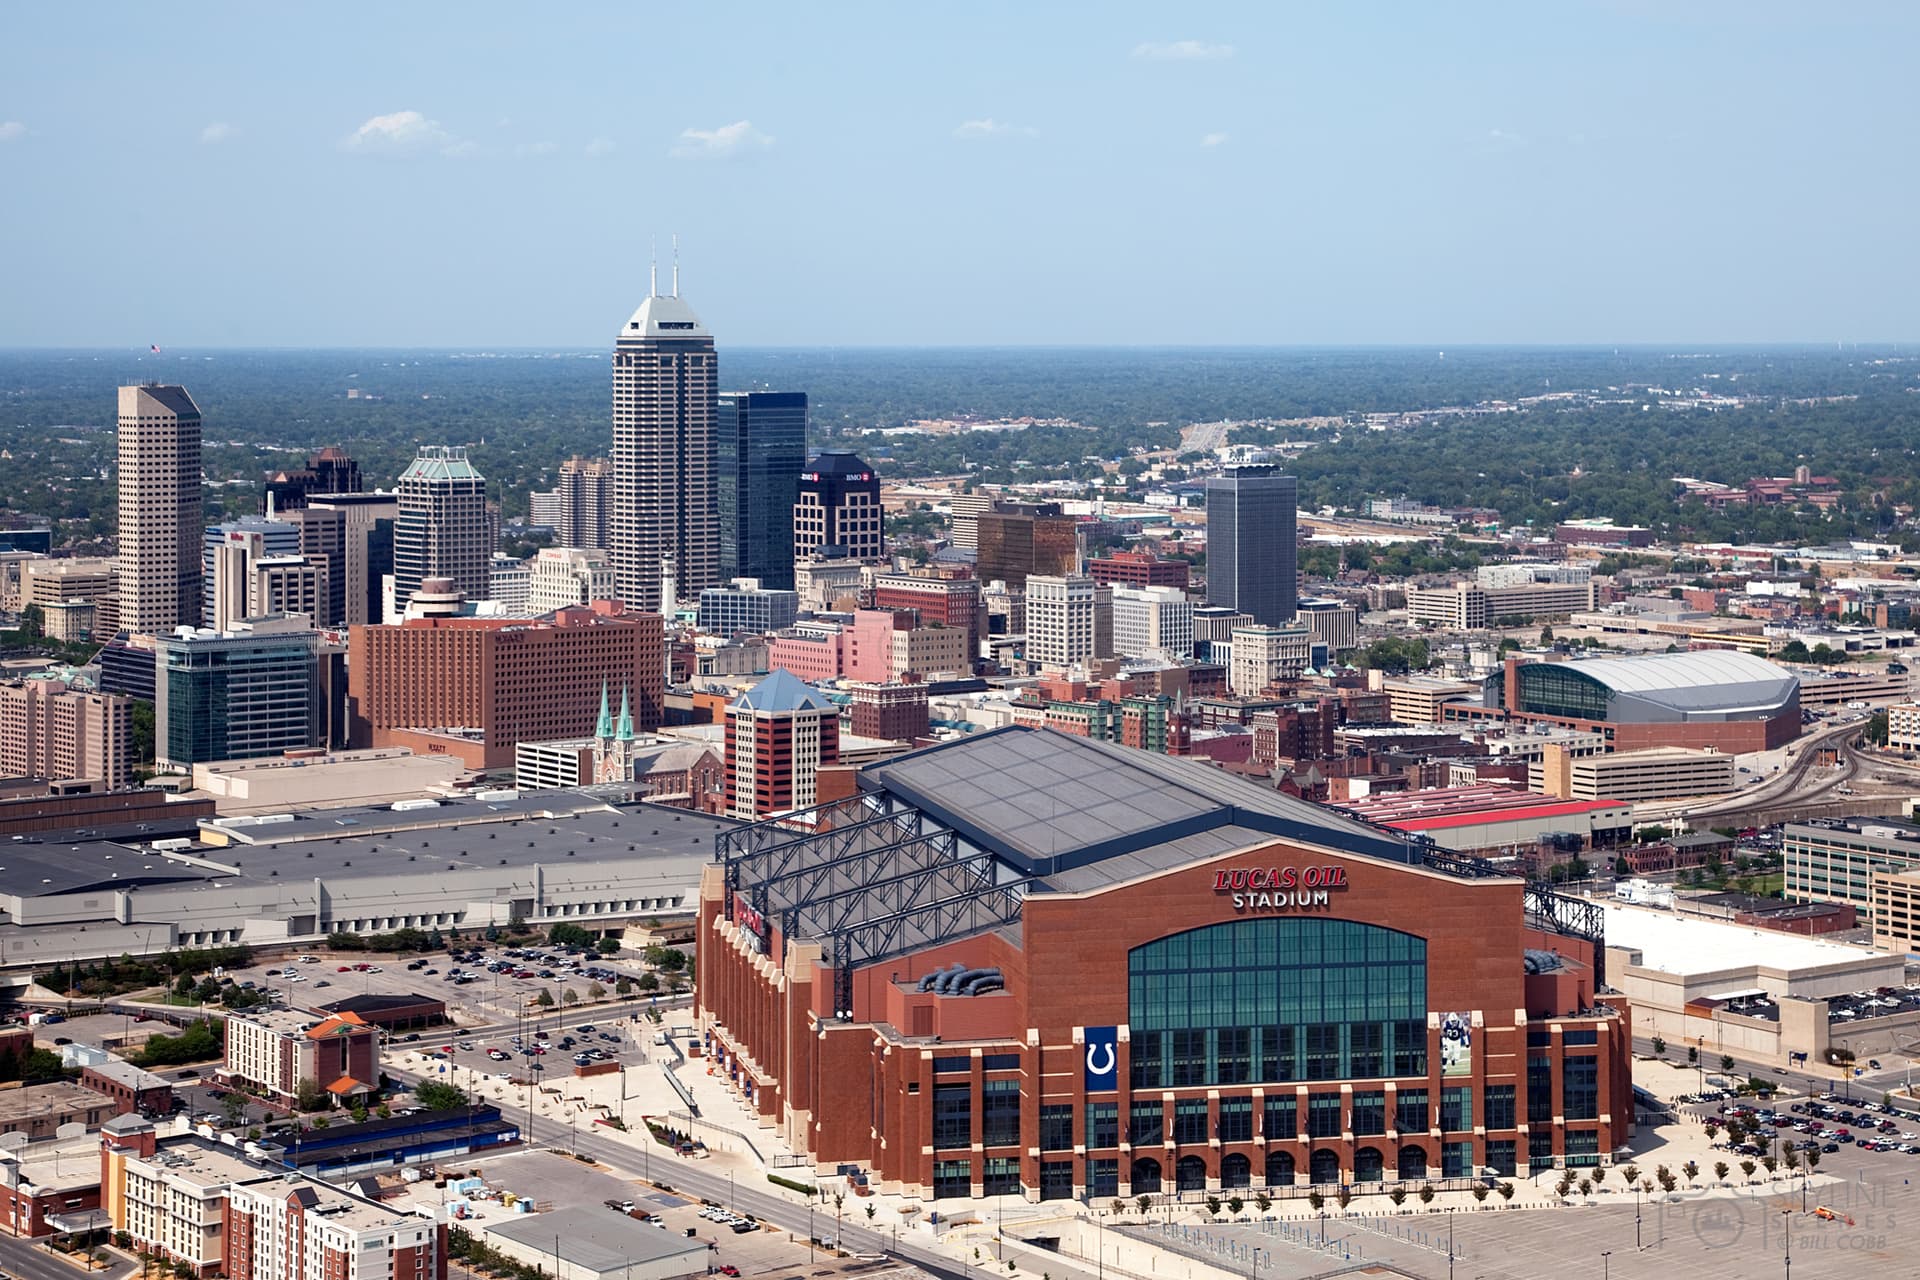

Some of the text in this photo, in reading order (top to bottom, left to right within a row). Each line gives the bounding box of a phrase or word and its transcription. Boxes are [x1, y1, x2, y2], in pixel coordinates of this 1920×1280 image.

[1213, 865, 1348, 890] LUCAS OIL
[1233, 890, 1329, 908] STADIUM
